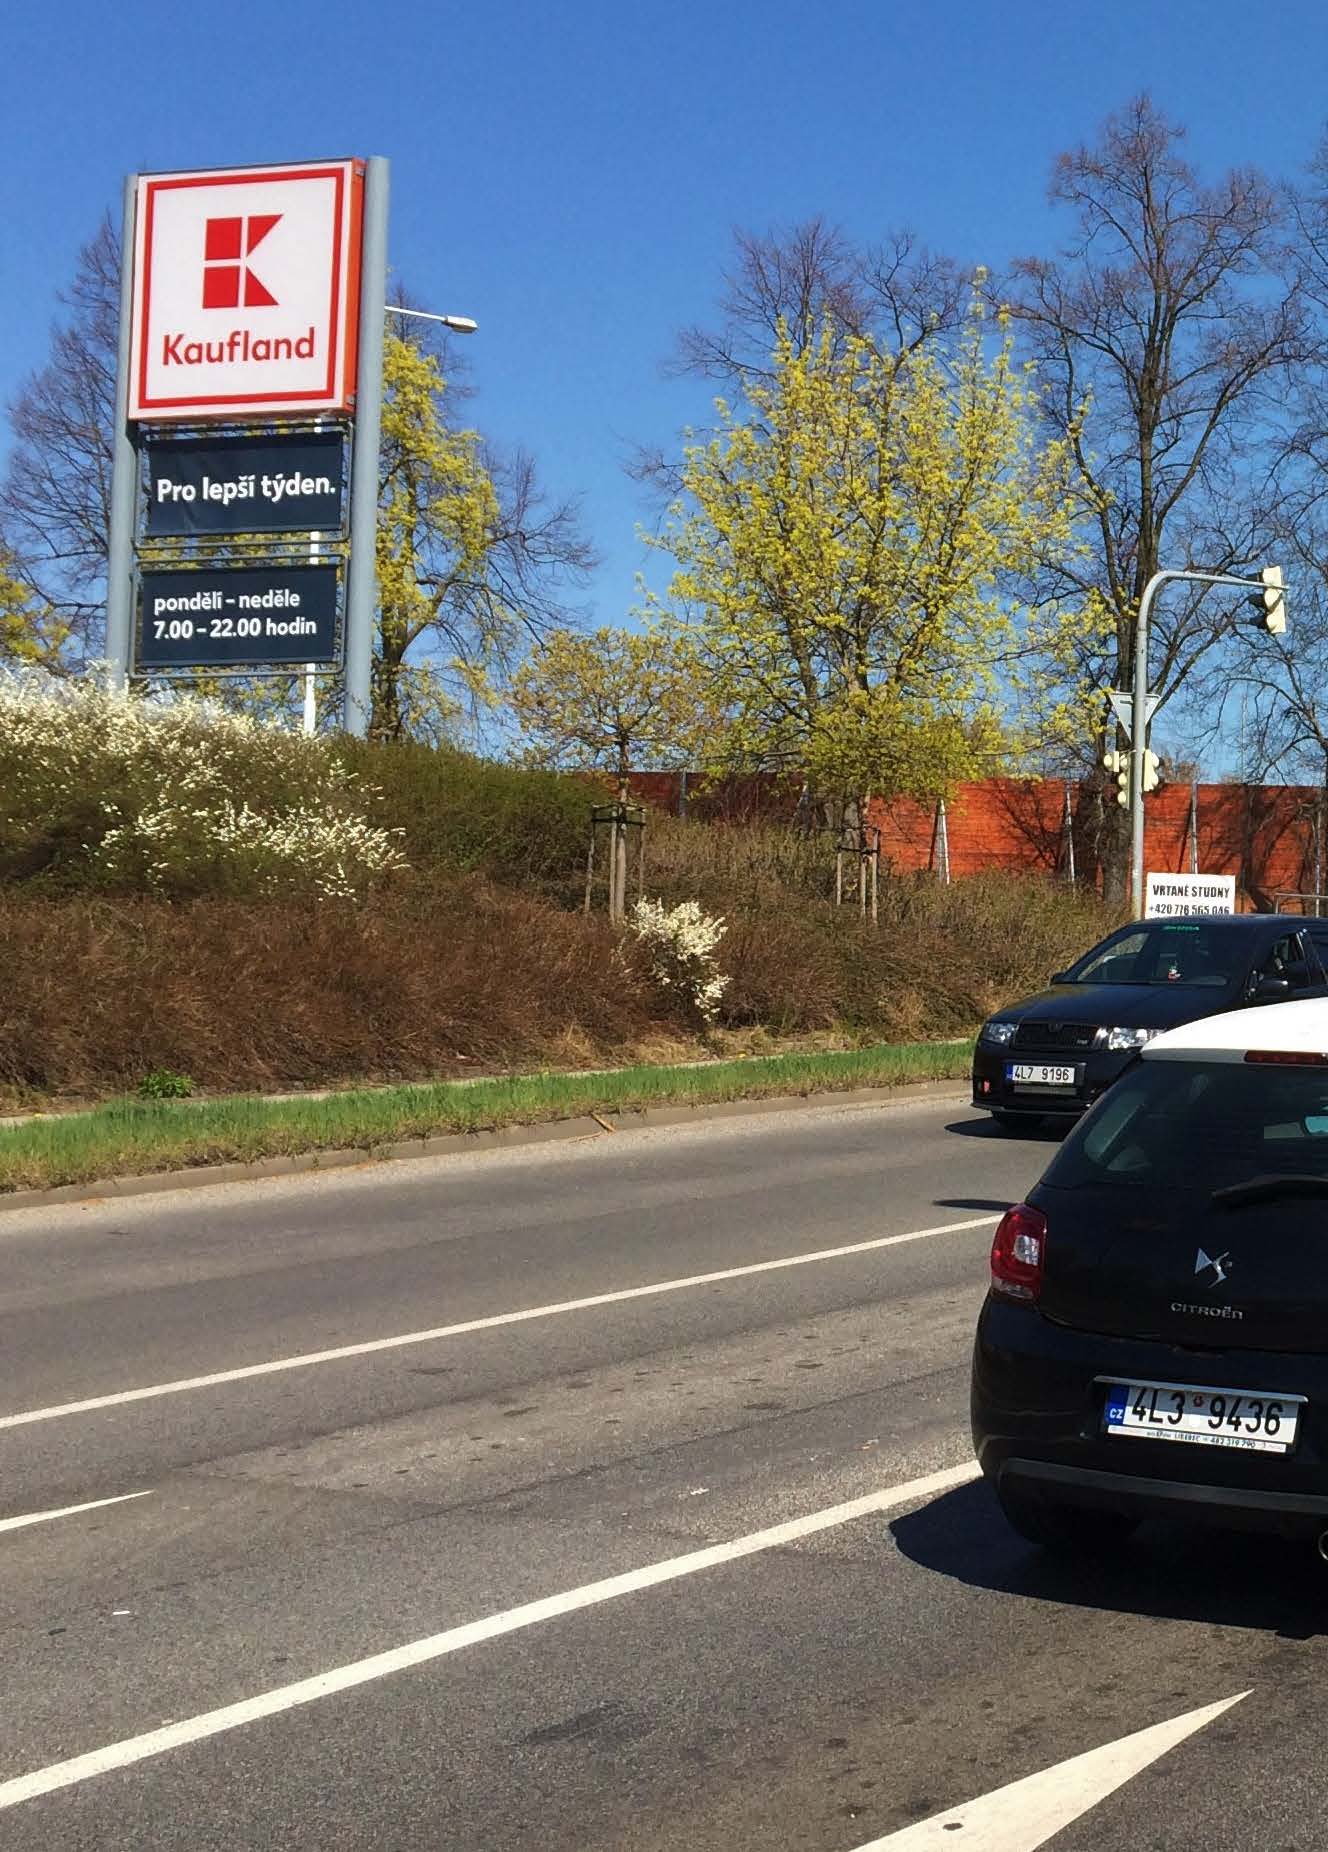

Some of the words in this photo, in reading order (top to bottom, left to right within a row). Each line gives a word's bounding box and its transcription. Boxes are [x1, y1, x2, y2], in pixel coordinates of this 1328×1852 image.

[162, 326, 315, 367] Kaufland
[157, 478, 196, 503] Pro
[202, 473, 255, 505] lepší
[260, 471, 336, 502] týden.
[153, 591, 223, 616] pondělí
[238, 588, 300, 609] neděle
[153, 619, 194, 640] 7.00
[209, 617, 261, 638] 22.00
[265, 616, 318, 637] hodin
[1152, 884, 1190, 897] VRTANÉ
[1191, 886, 1231, 898] STUDNY
[1014, 1066, 1033, 1080] 4L7
[1041, 1067, 1070, 1081] 9196
[1109, 1407, 1124, 1420] CZ
[1131, 1386, 1186, 1426] 4L3
[1207, 1393, 1284, 1436] 9436
